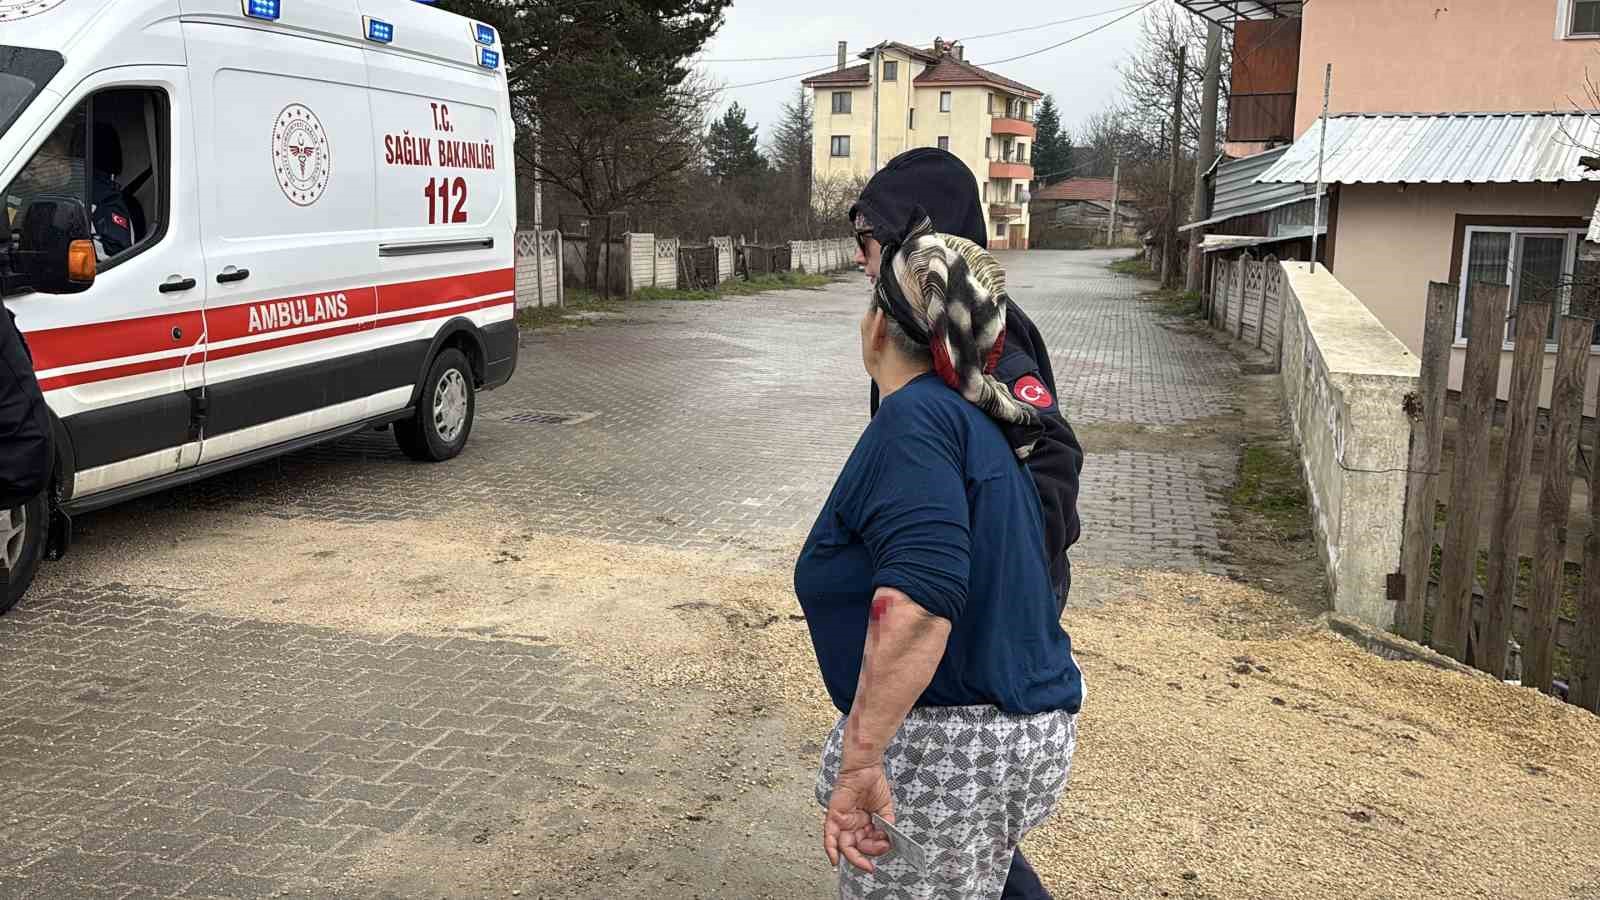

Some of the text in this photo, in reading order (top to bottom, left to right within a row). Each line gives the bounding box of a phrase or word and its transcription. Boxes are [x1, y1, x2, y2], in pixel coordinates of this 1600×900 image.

[430, 102, 454, 133] T.C.
[384, 129, 495, 170] SAĞLIK BAKANLIĞI
[424, 176, 467, 224] 112
[247, 293, 348, 332] AMBULANS
